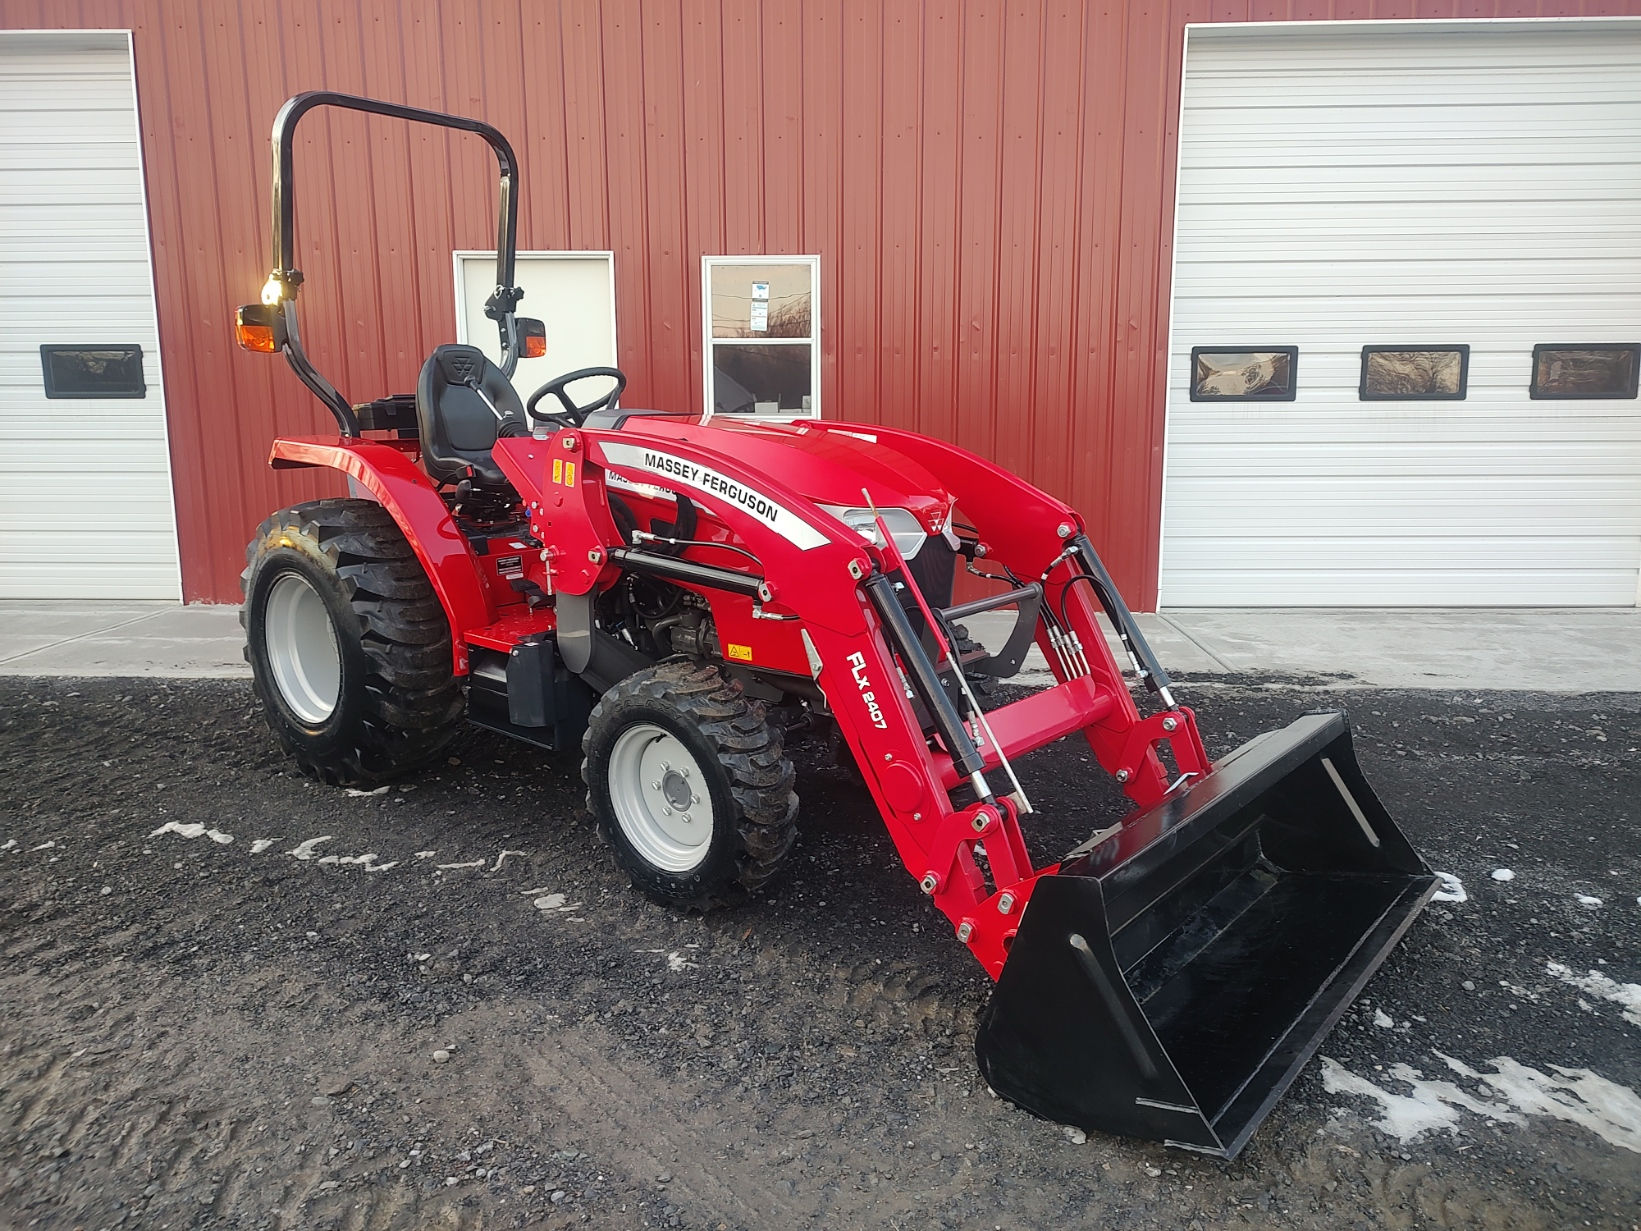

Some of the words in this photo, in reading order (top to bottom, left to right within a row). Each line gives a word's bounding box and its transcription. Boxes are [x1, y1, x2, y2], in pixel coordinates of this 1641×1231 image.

[644, 453, 700, 482] MASSEY
[702, 472, 778, 522] FERGUSON
[846, 651, 871, 691] FLX
[862, 691, 888, 729] 2407
